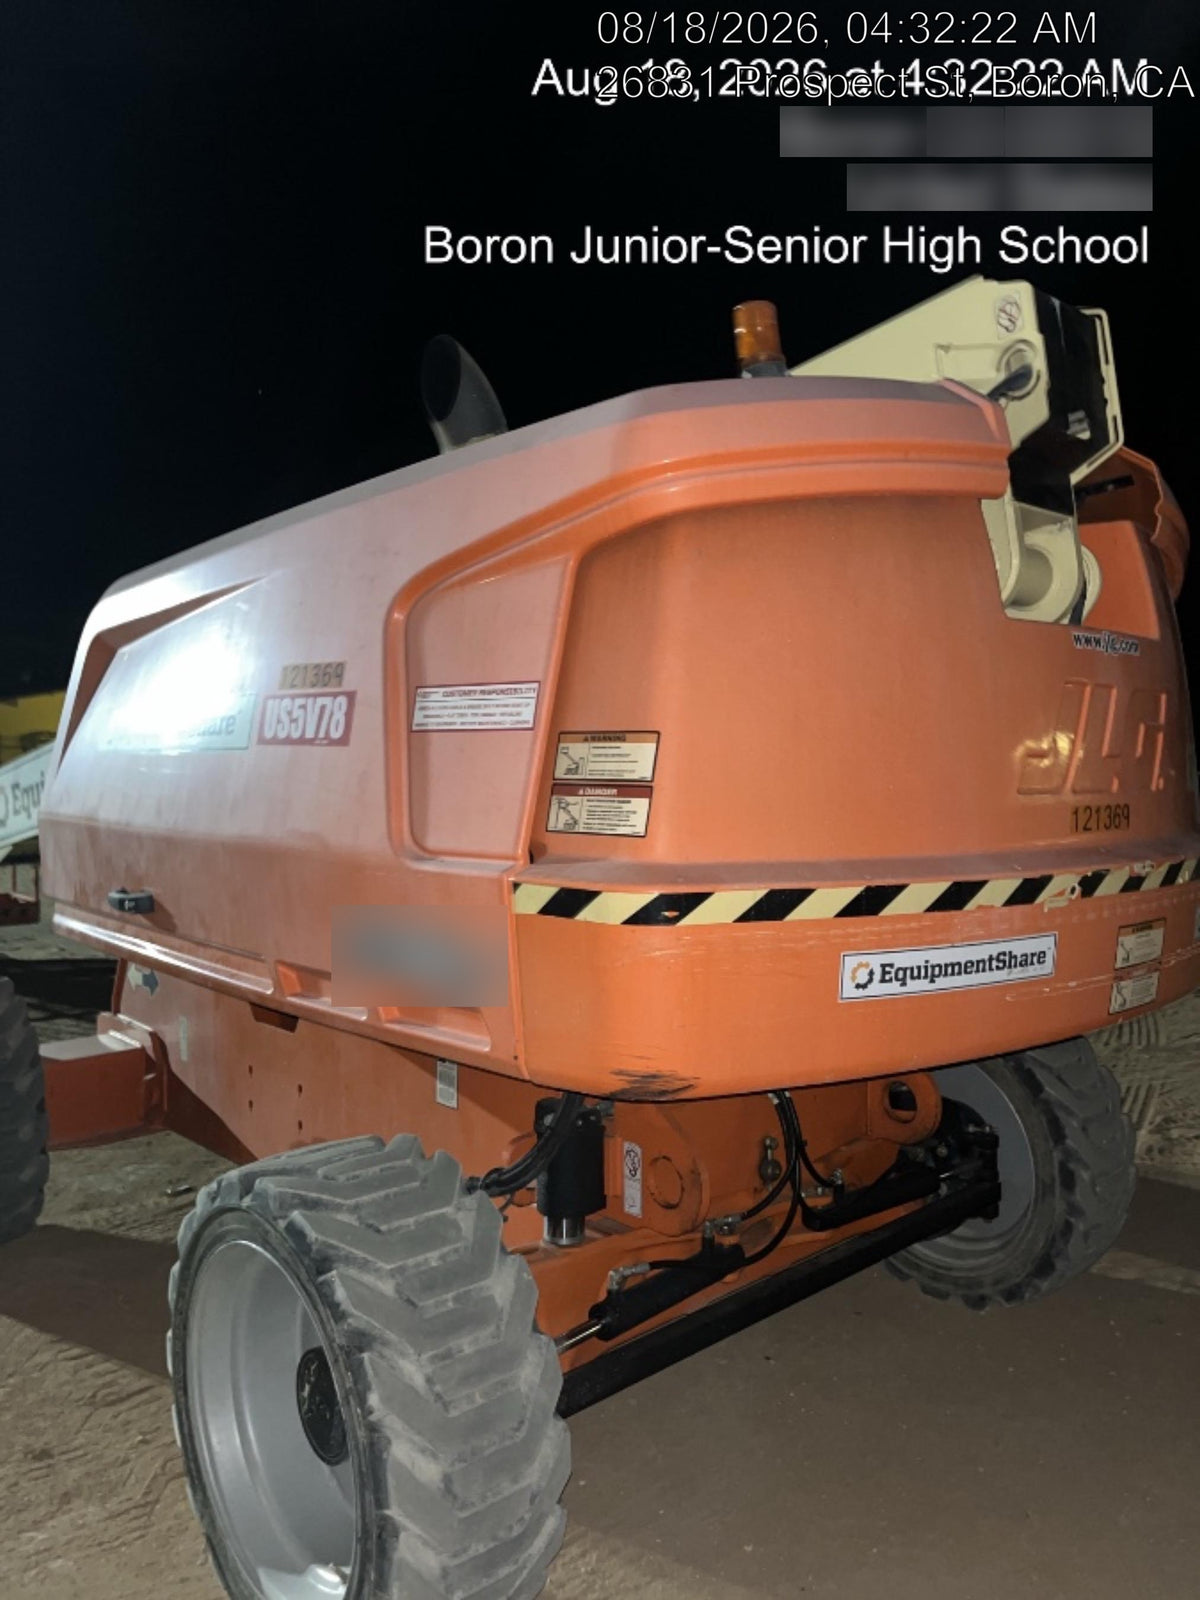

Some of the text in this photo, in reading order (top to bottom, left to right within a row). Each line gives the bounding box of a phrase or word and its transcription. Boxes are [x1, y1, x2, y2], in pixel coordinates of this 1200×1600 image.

[264, 695, 348, 740] US5V78
[1072, 803, 1130, 832] 121369
[879, 949, 1047, 987] EquipmentShare
